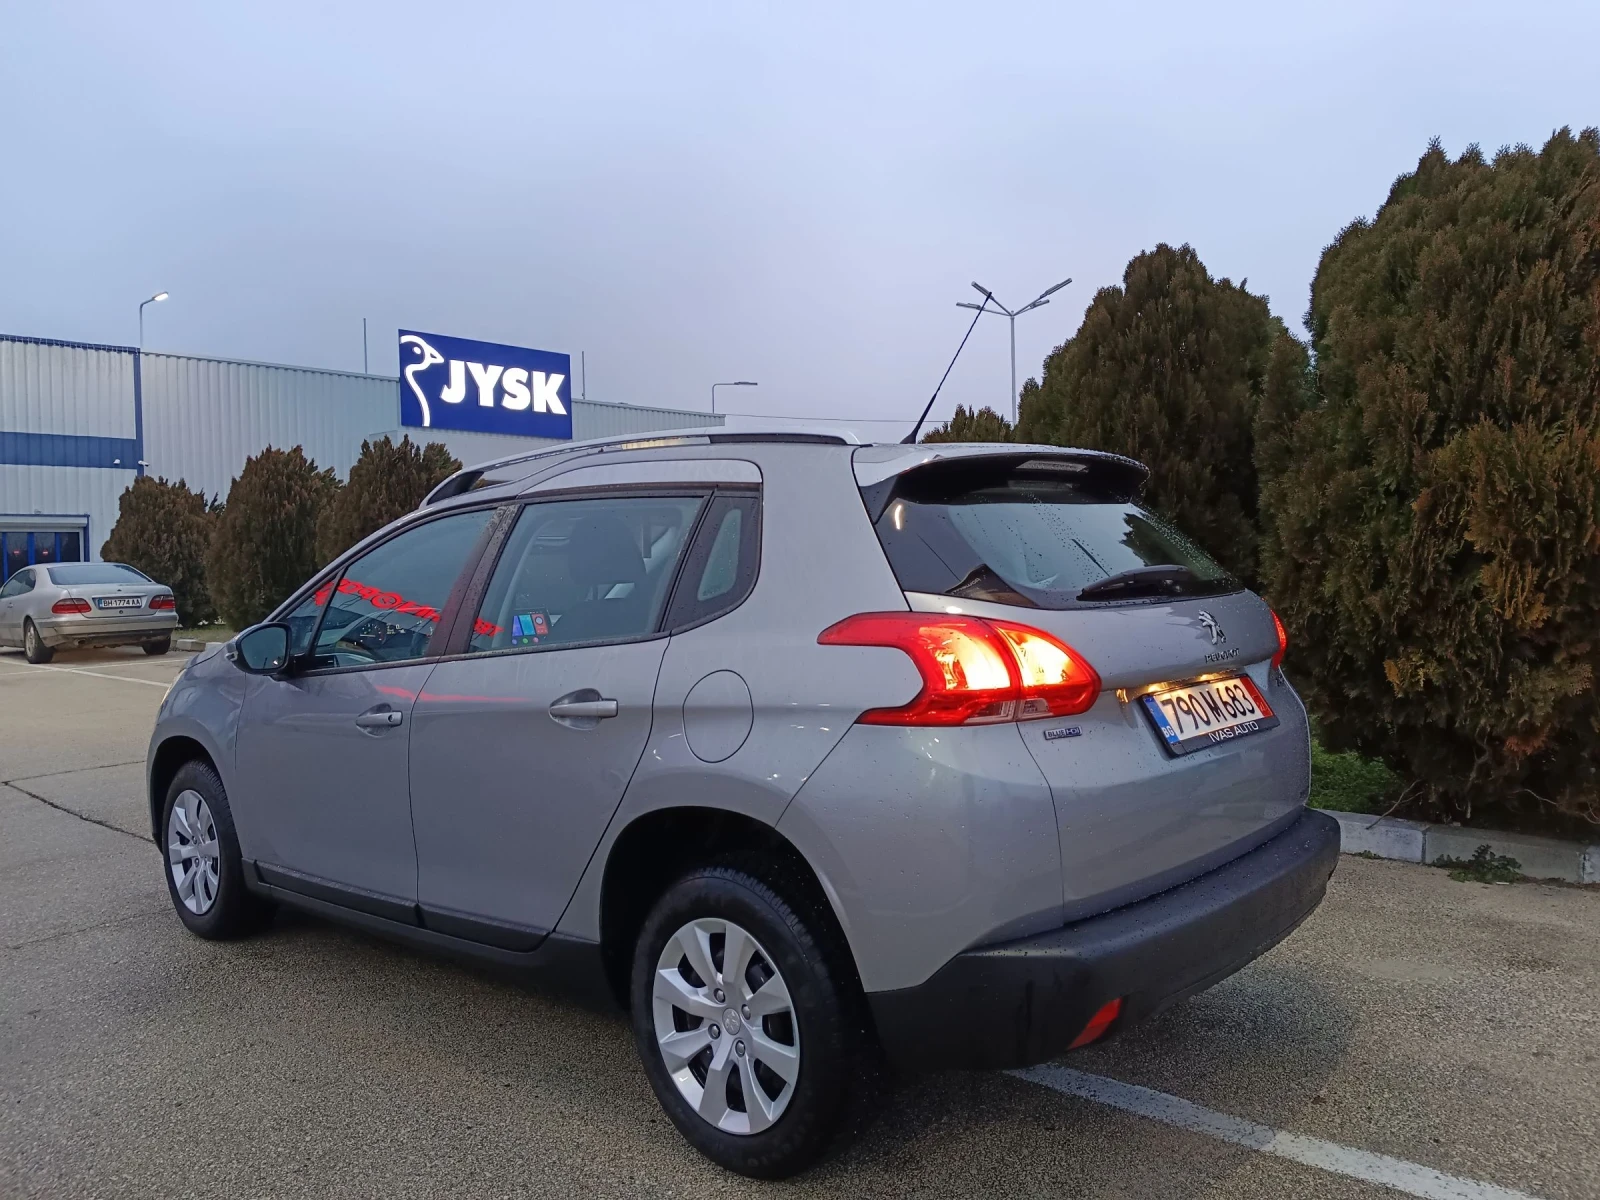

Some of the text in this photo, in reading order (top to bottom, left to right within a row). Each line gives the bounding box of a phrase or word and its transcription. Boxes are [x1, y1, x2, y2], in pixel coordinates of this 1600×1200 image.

[440, 359, 567, 415] JYSK
[103, 599, 112, 607] BH
[131, 598, 141, 606] AA
[1161, 725, 1175, 739] BG
[1208, 720, 1259, 743] IVAS AUTO
